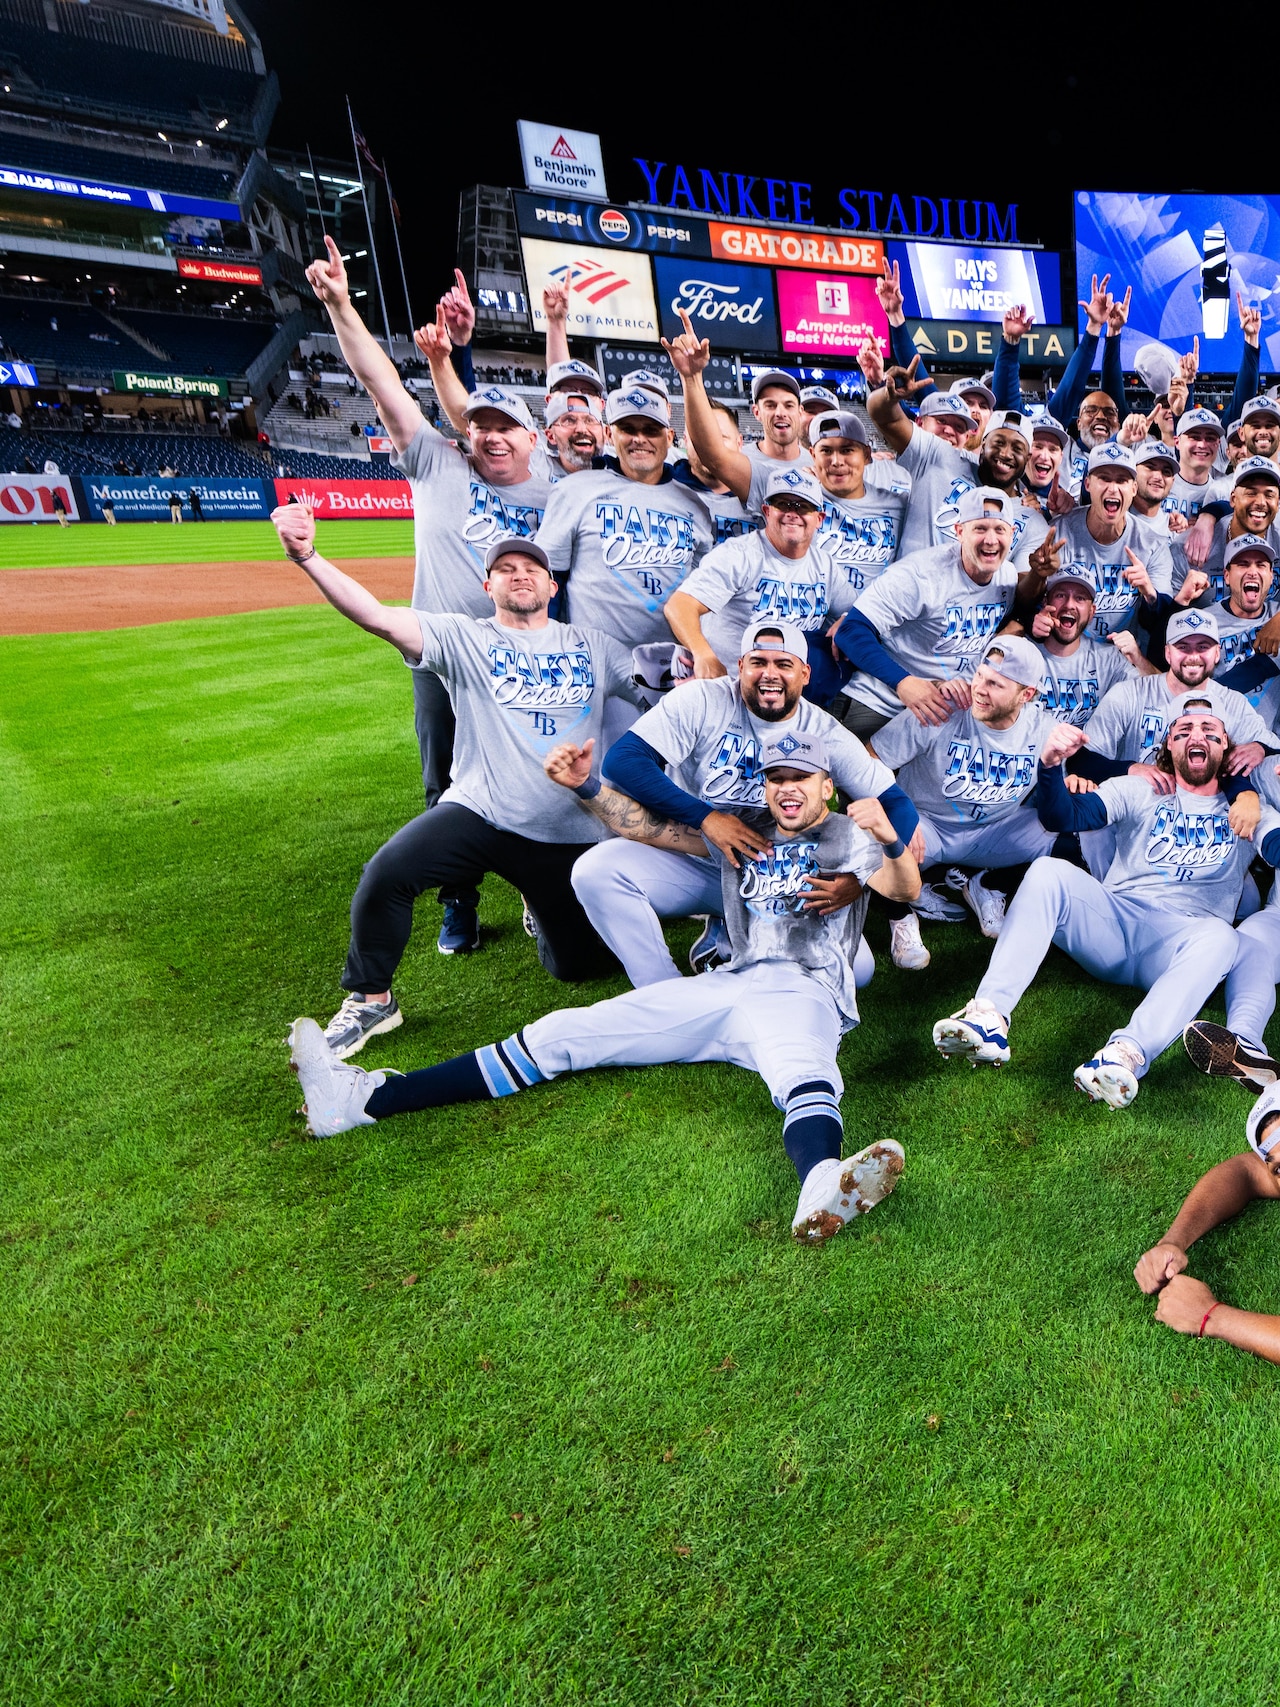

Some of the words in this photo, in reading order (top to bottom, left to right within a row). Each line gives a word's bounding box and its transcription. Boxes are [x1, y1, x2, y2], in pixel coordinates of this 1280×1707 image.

[534, 155, 596, 178] Benjamin
[544, 170, 588, 188] Moore
[632, 157, 815, 225] YANKEE
[838, 188, 1020, 244] STADIUM
[535, 208, 582, 227] PEPSI
[601, 220, 629, 231] PEPSI
[647, 225, 691, 242] PEPSI
[720, 230, 877, 267] GATORADE
[203, 265, 260, 282] Budweiser
[954, 258, 998, 282] RAYS
[671, 279, 763, 324] Ford
[825, 288, 842, 309] T
[940, 288, 1014, 312] YANKEES
[534, 310, 571, 322] BK
[575, 314, 592, 324] OF
[595, 317, 655, 330] AMERICA
[796, 319, 874, 335] America's
[785, 329, 819, 344] Best
[947, 329, 1065, 357] DETA
[125, 373, 173, 390] Poland
[173, 376, 219, 396] Spring
[191, 484, 259, 501] Einstein
[214, 503, 237, 511] Human
[238, 504, 262, 512] Health
[596, 504, 693, 550] TAKE
[819, 501, 895, 549] TAKE
[602, 532, 694, 567] October
[816, 530, 893, 564] October
[637, 571, 663, 596] TB
[844, 566, 864, 590] TB
[753, 578, 828, 618] TAKE
[488, 644, 594, 688] TAKE
[492, 675, 594, 706] October
[1038, 677, 1099, 711] AKE
[528, 711, 557, 736] TB
[946, 741, 1035, 788] TAKE
[941, 772, 1027, 802] October
[1150, 804, 1234, 848] TAKE
[1144, 834, 1234, 866] October
